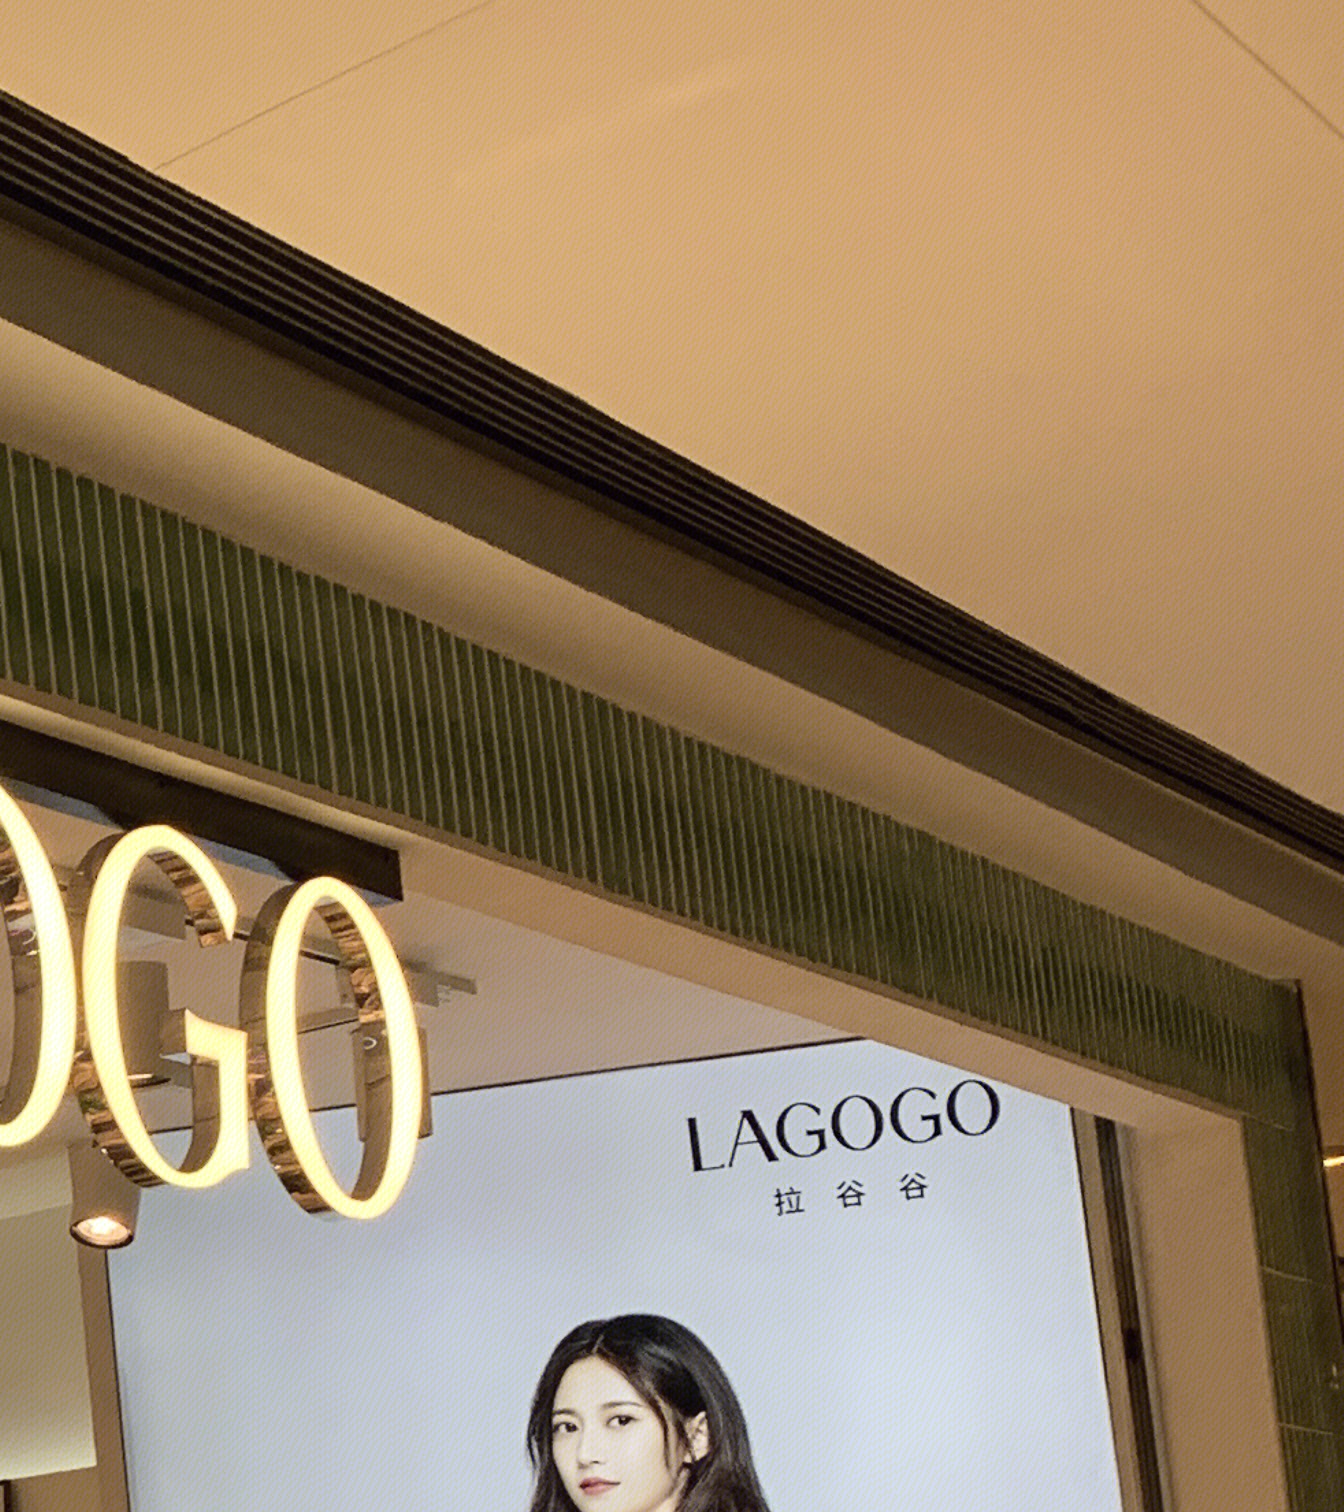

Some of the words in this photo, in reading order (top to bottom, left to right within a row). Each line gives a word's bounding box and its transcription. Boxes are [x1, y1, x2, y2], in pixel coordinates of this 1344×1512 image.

[686, 1079, 1001, 1172] LAGOGO
[774, 1171, 928, 1216] 拉谷谷
